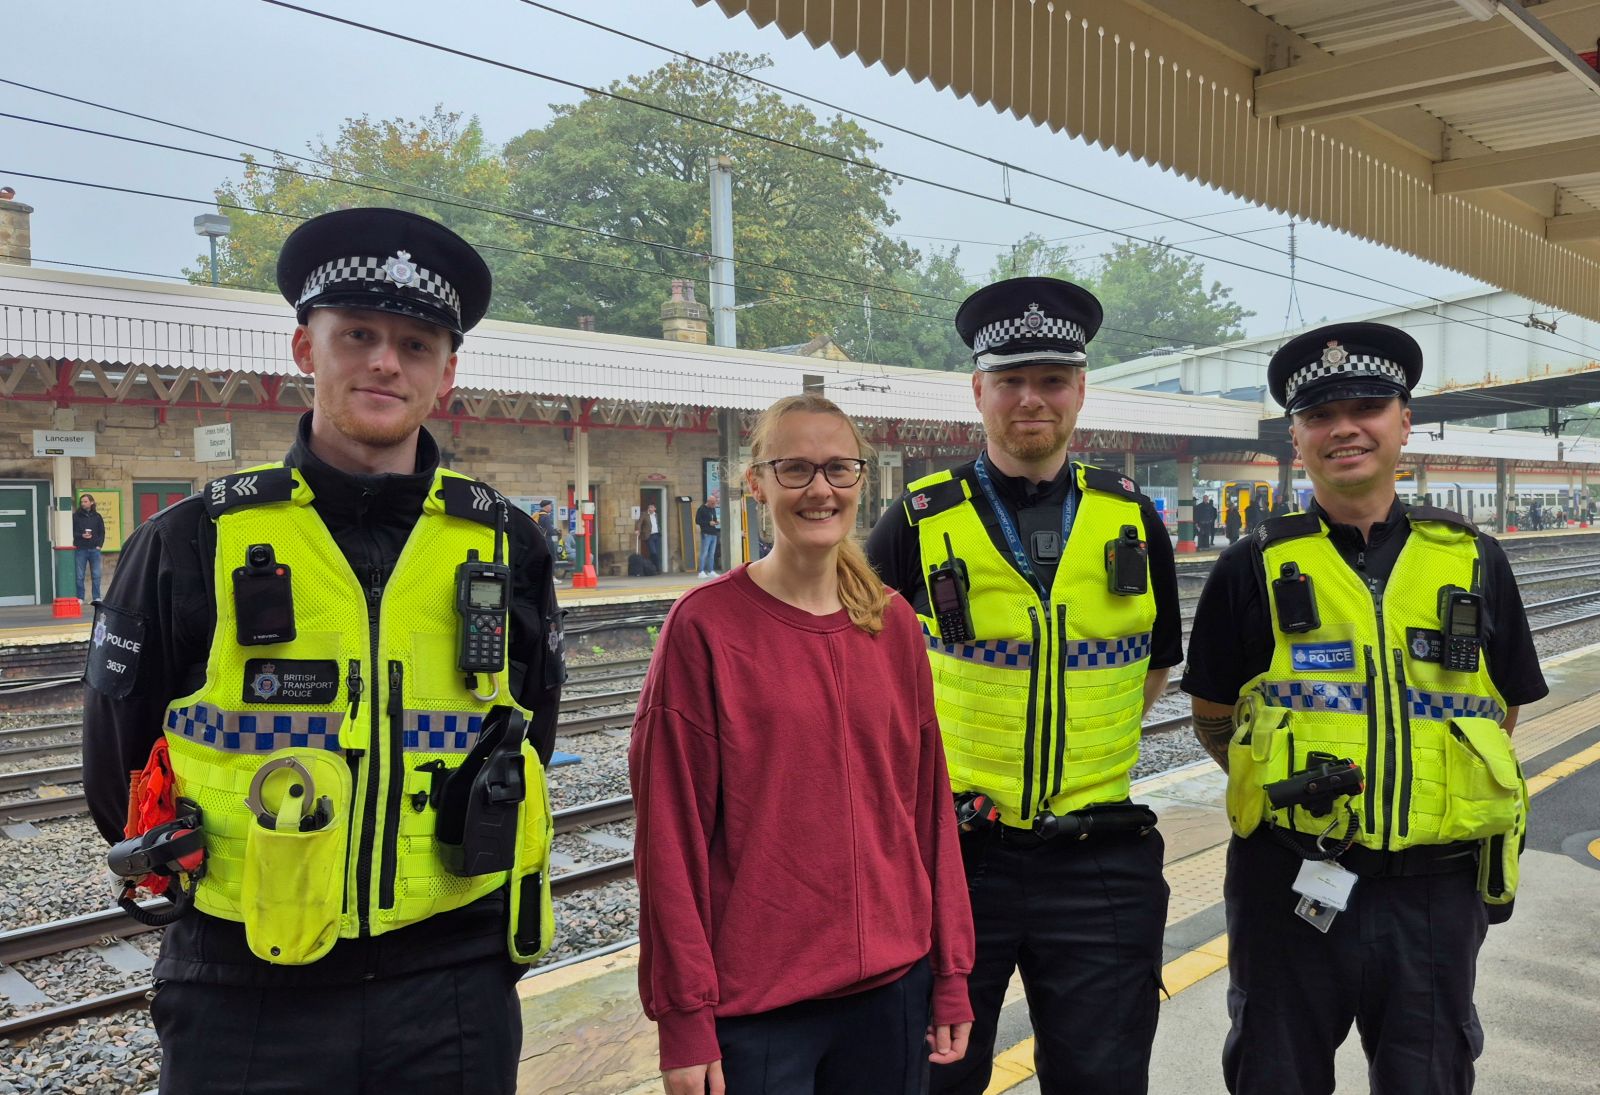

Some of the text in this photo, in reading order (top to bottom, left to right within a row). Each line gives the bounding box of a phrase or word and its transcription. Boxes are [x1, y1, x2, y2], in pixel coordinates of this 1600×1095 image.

[45, 435, 84, 443] Lancaster
[211, 479, 226, 505] 3637
[1005, 525, 1017, 543] POLICE
[107, 632, 141, 653] POLICE
[1309, 652, 1352, 662] POLICE
[107, 659, 126, 674] 3637
[283, 681, 333, 689] TRANSPORT
